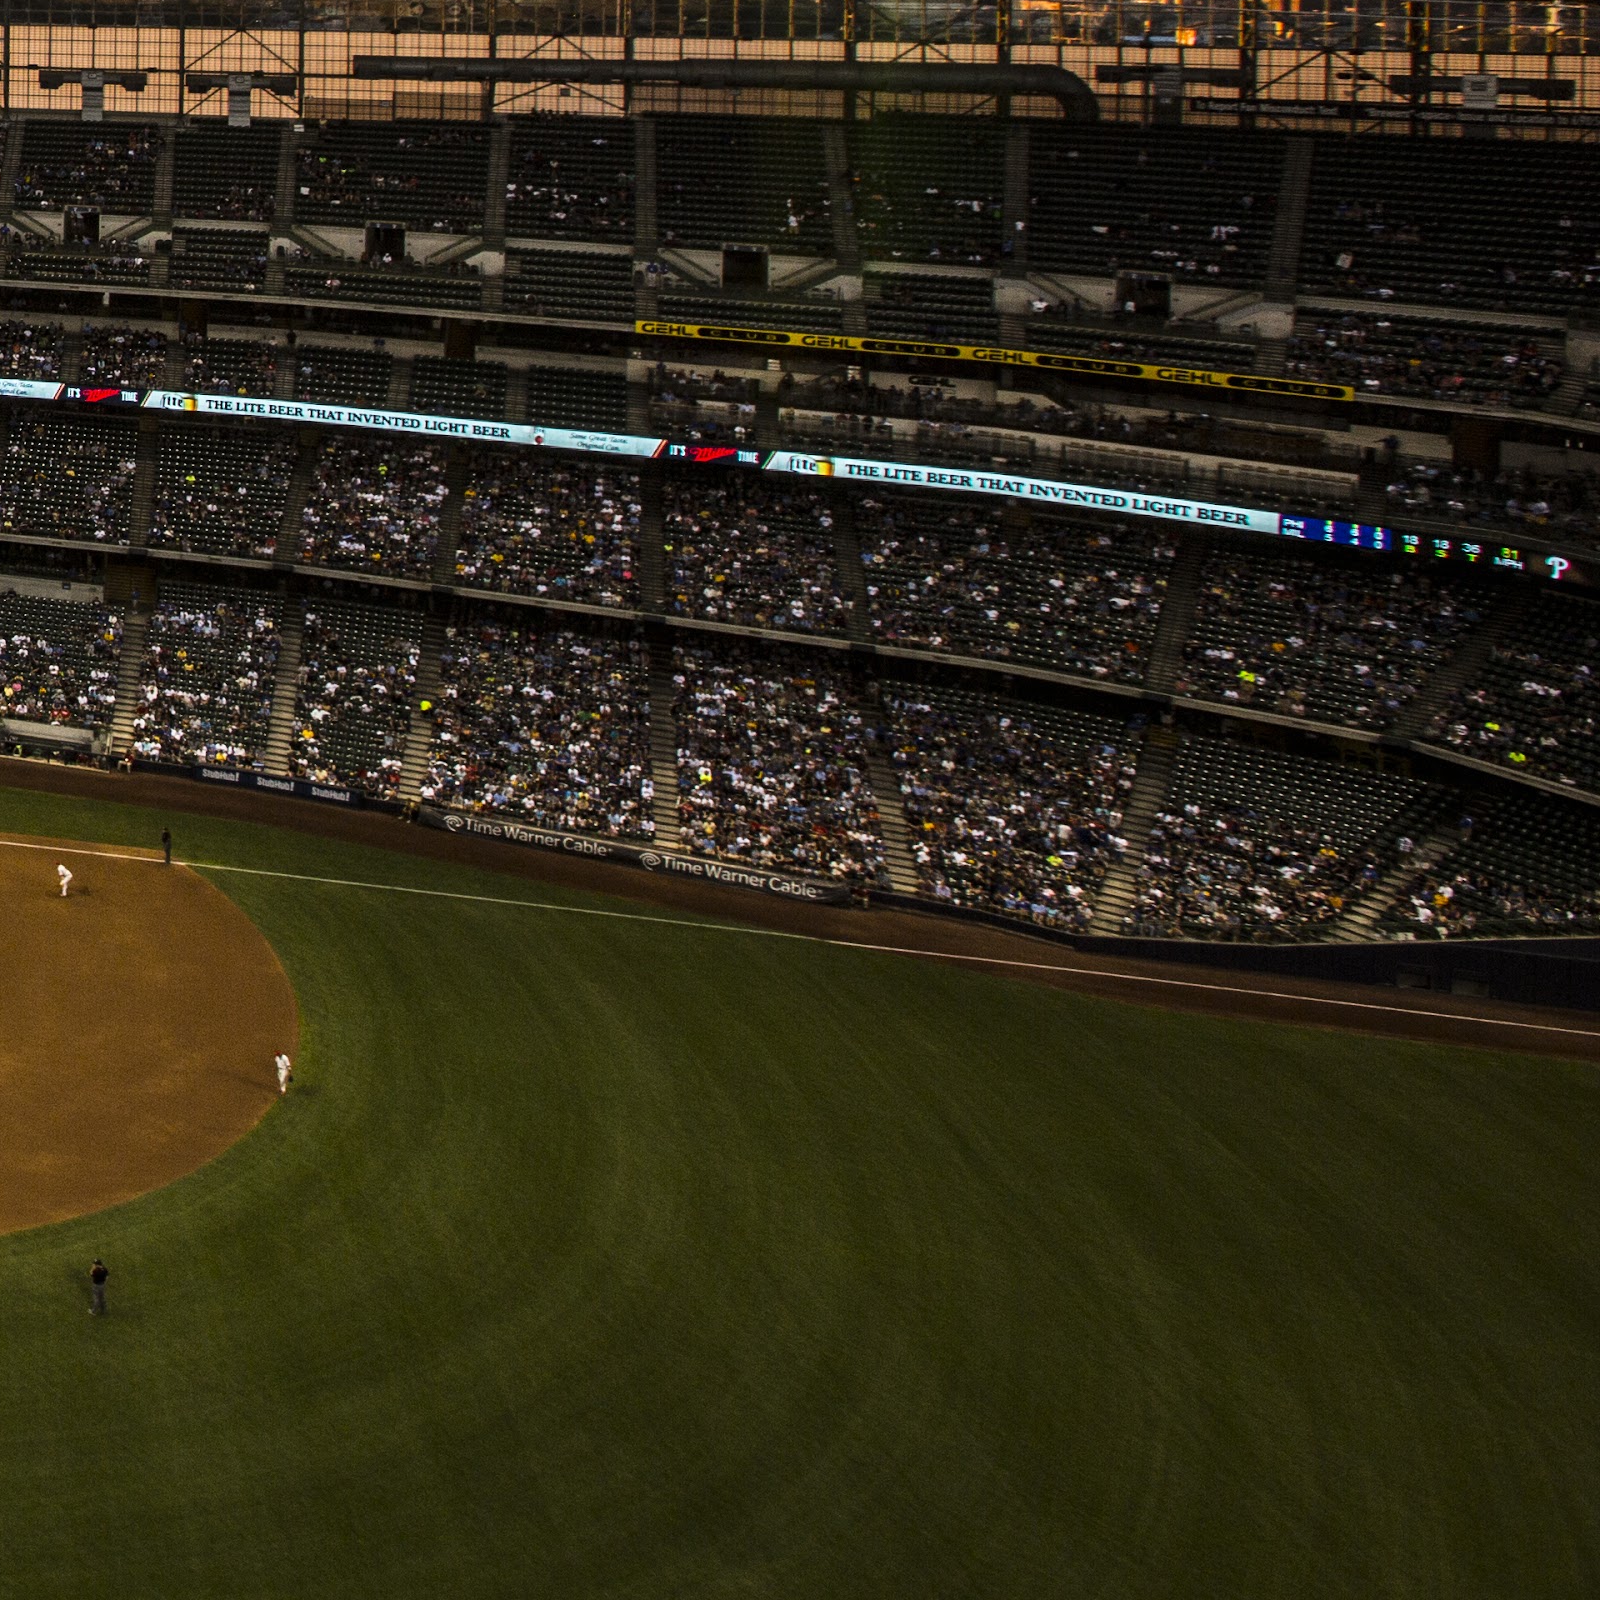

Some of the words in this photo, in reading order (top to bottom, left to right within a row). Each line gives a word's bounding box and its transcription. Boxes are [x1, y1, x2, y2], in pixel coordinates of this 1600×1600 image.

[642, 323, 694, 336] GEHL
[710, 329, 777, 341] CLUB
[801, 336, 857, 349] GEHL
[874, 342, 946, 355] CLUB
[972, 348, 1032, 364] GEHL
[1052, 357, 1127, 374] CLUB
[1157, 369, 1217, 385] GEHL
[67, 388, 80, 399] IT'S
[1243, 379, 1329, 396] CLUB
[206, 399, 233, 412] THE
[236, 402, 266, 414] LITE
[269, 404, 304, 418] BEER
[308, 408, 345, 421] THAT
[348, 412, 421, 429] INVENTED
[424, 420, 469, 434] LIGHT
[472, 425, 511, 439] BEER
[670, 444, 686, 457] IT'S
[689, 447, 736, 462] Miller
[738, 451, 758, 464] TIME
[845, 463, 880, 479] THE
[884, 467, 923, 483] LITE
[926, 471, 973, 487] BEER
[977, 477, 1025, 493] THAT
[1029, 482, 1127, 508] INVENTED
[1131, 497, 1192, 518] LIGHT
[1197, 507, 1250, 526] BEER
[1282, 518, 1305, 529] PHI
[1281, 527, 1305, 539] MIL
[1373, 540, 1384, 549] 0
[1401, 534, 1420, 546] 18
[1432, 539, 1451, 550] 18
[1435, 550, 1449, 558] S
[1466, 554, 1479, 562] T
[1493, 557, 1524, 570] MPH
[1545, 556, 1570, 580] P
[202, 768, 240, 782] StubHub!
[257, 777, 295, 792] StubHub!
[312, 786, 350, 802] StubHub!
[465, 817, 502, 836] Time
[503, 825, 561, 848] Warner
[563, 837, 607, 857] Cable
[661, 856, 703, 876] Time
[704, 863, 766, 888] Warner
[769, 877, 817, 898] Cable
